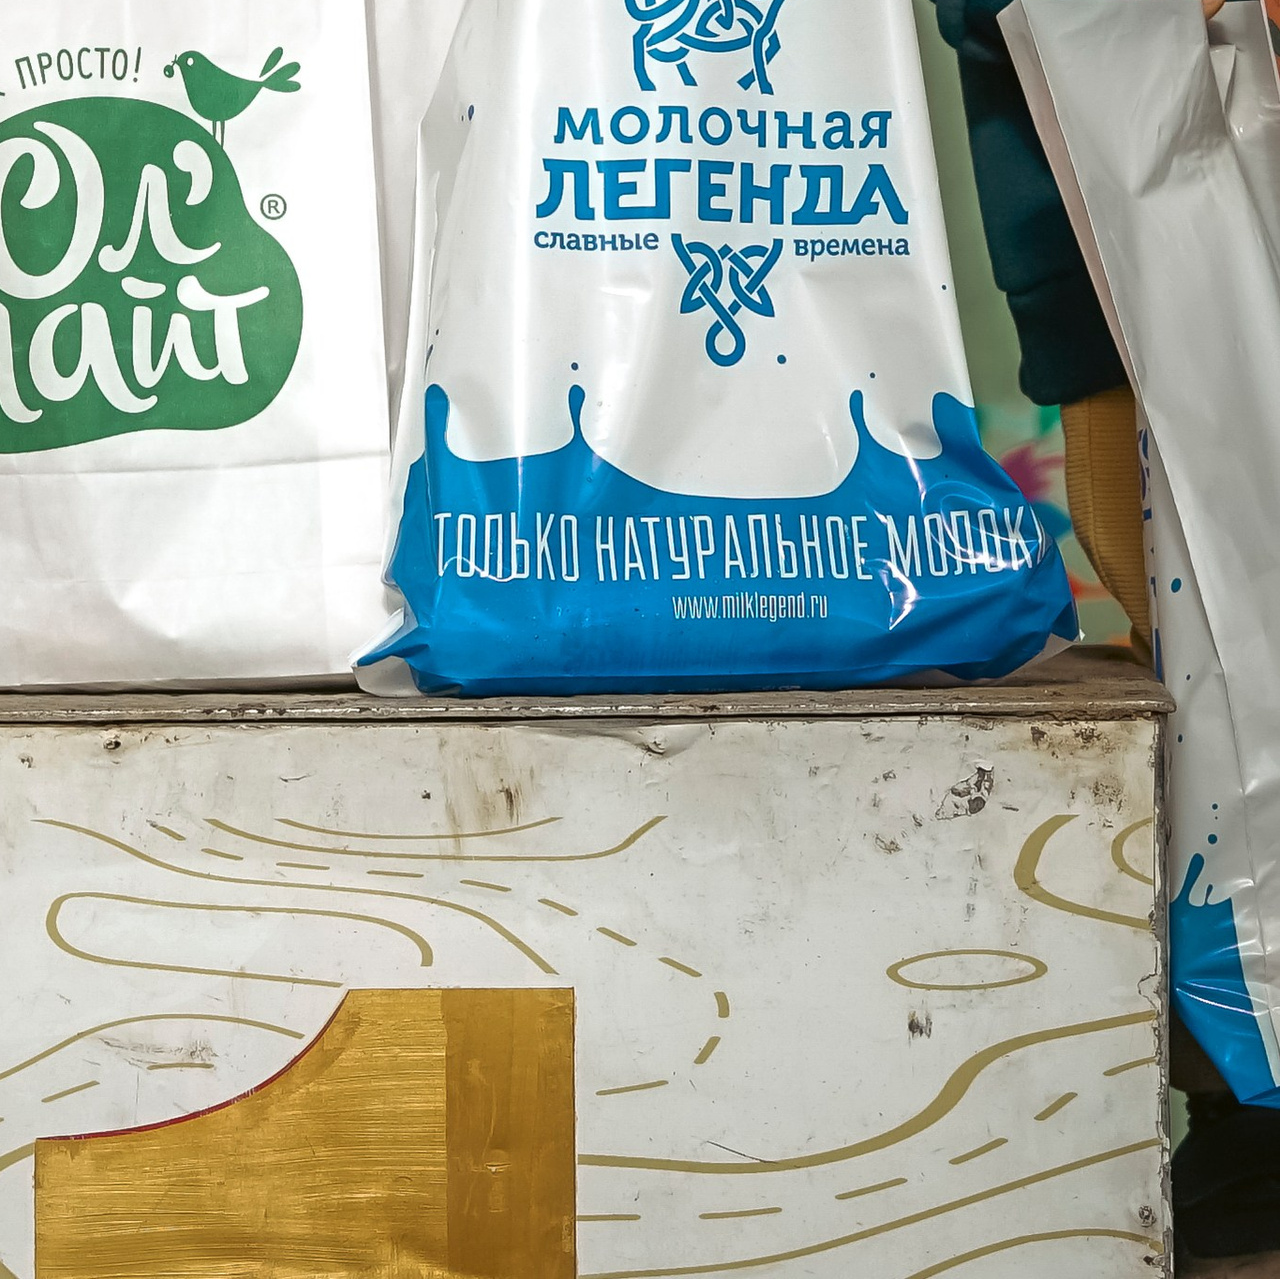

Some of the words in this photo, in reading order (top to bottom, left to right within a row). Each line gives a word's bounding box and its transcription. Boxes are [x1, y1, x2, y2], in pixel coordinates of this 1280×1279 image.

[15, 46, 142, 90] ПРОСТО!
[535, 158, 909, 225] ЛЕГЕНДА
[533, 228, 660, 253] славные
[793, 234, 910, 260] времена
[434, 512, 578, 582] ТОЛЬКО
[596, 514, 873, 581] НАТУРАЛЬНОЕ
[672, 591, 827, 622] www.milklegend.ru
